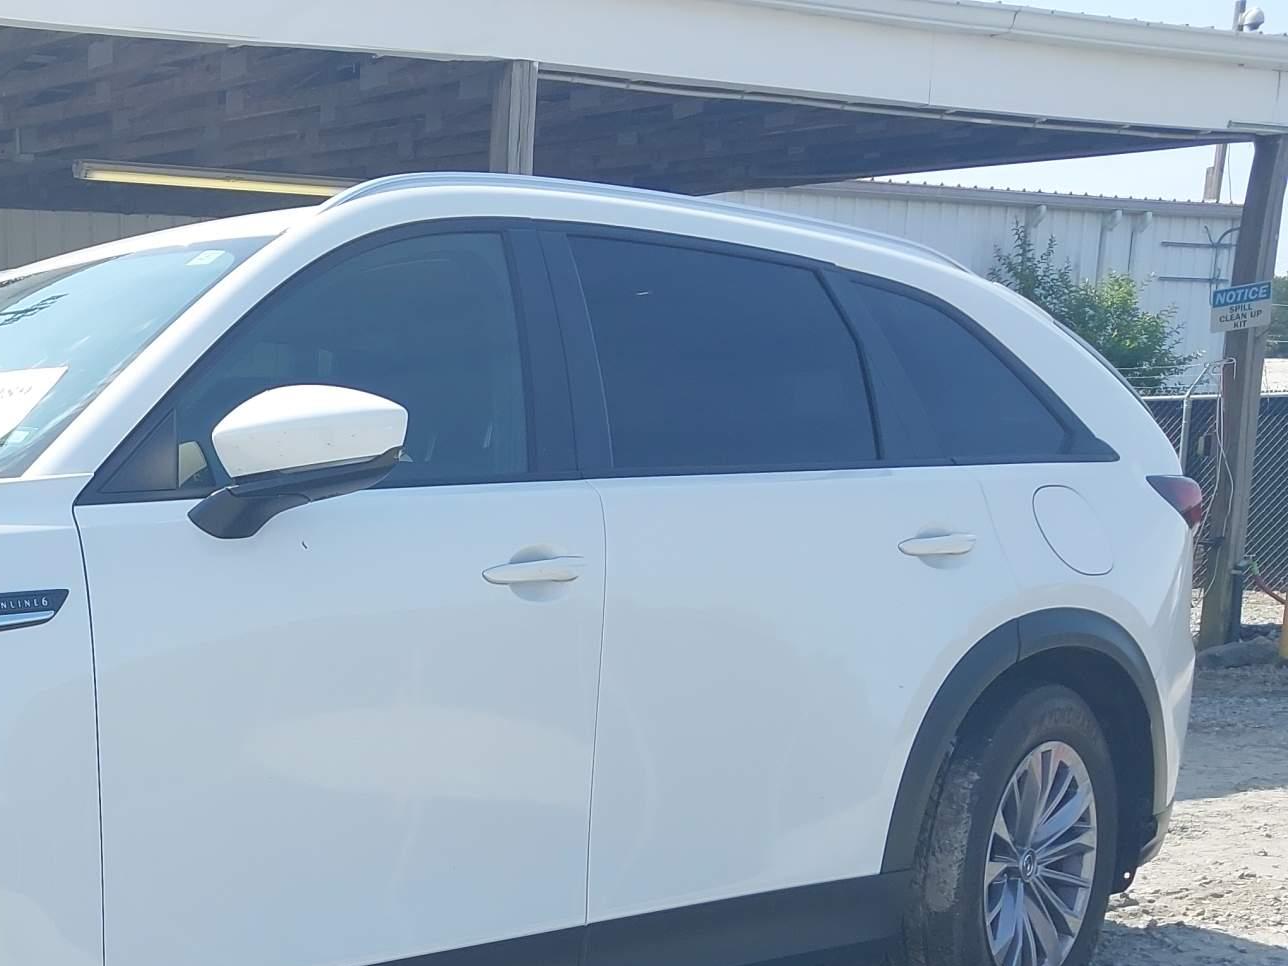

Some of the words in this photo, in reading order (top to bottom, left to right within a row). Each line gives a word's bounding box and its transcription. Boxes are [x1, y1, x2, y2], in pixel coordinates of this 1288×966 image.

[1216, 286, 1268, 304] NOTICE
[1229, 304, 1253, 314] SPILL
[1219, 313, 1248, 323] CLEAN
[1250, 310, 1263, 319] UP
[1233, 320, 1248, 329] KIT
